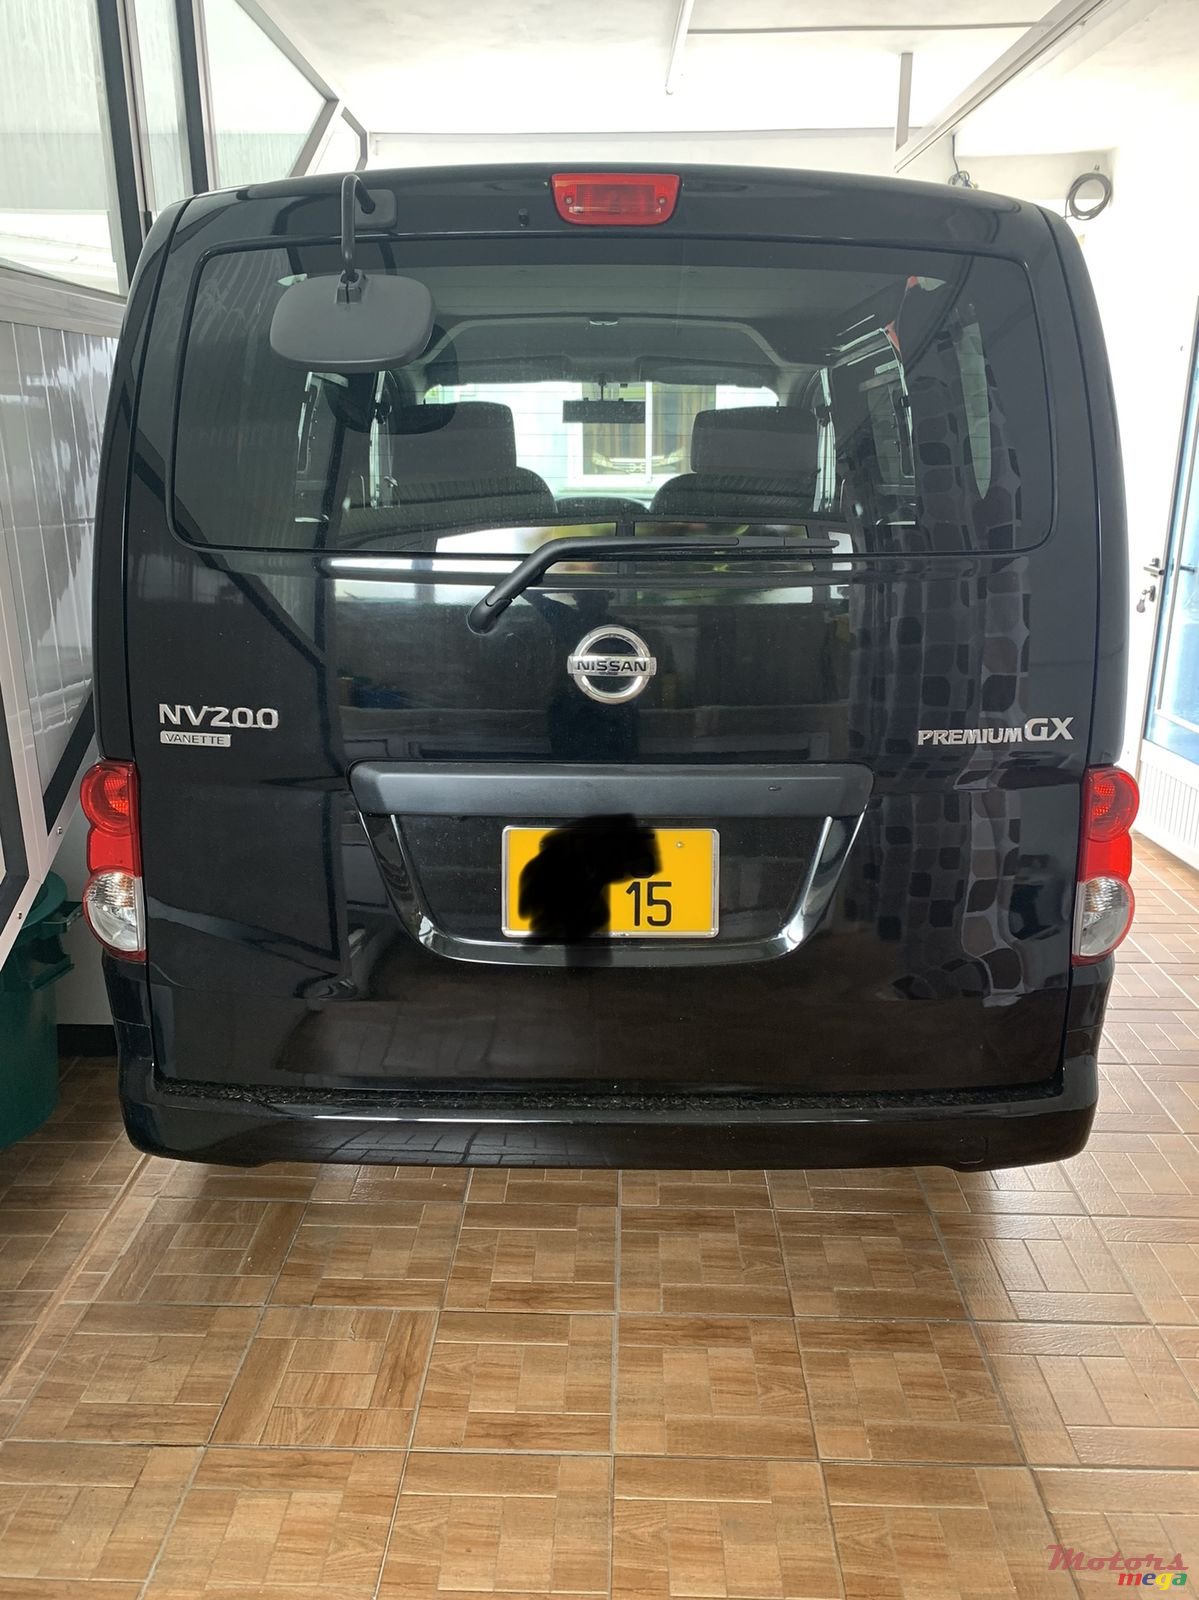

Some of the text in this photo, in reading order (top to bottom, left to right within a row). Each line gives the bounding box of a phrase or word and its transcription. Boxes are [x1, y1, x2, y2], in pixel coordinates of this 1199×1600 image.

[576, 660, 648, 673] NISSAN
[158, 703, 279, 729] NV200
[165, 733, 225, 745] VANETTE
[625, 881, 672, 927] 15
